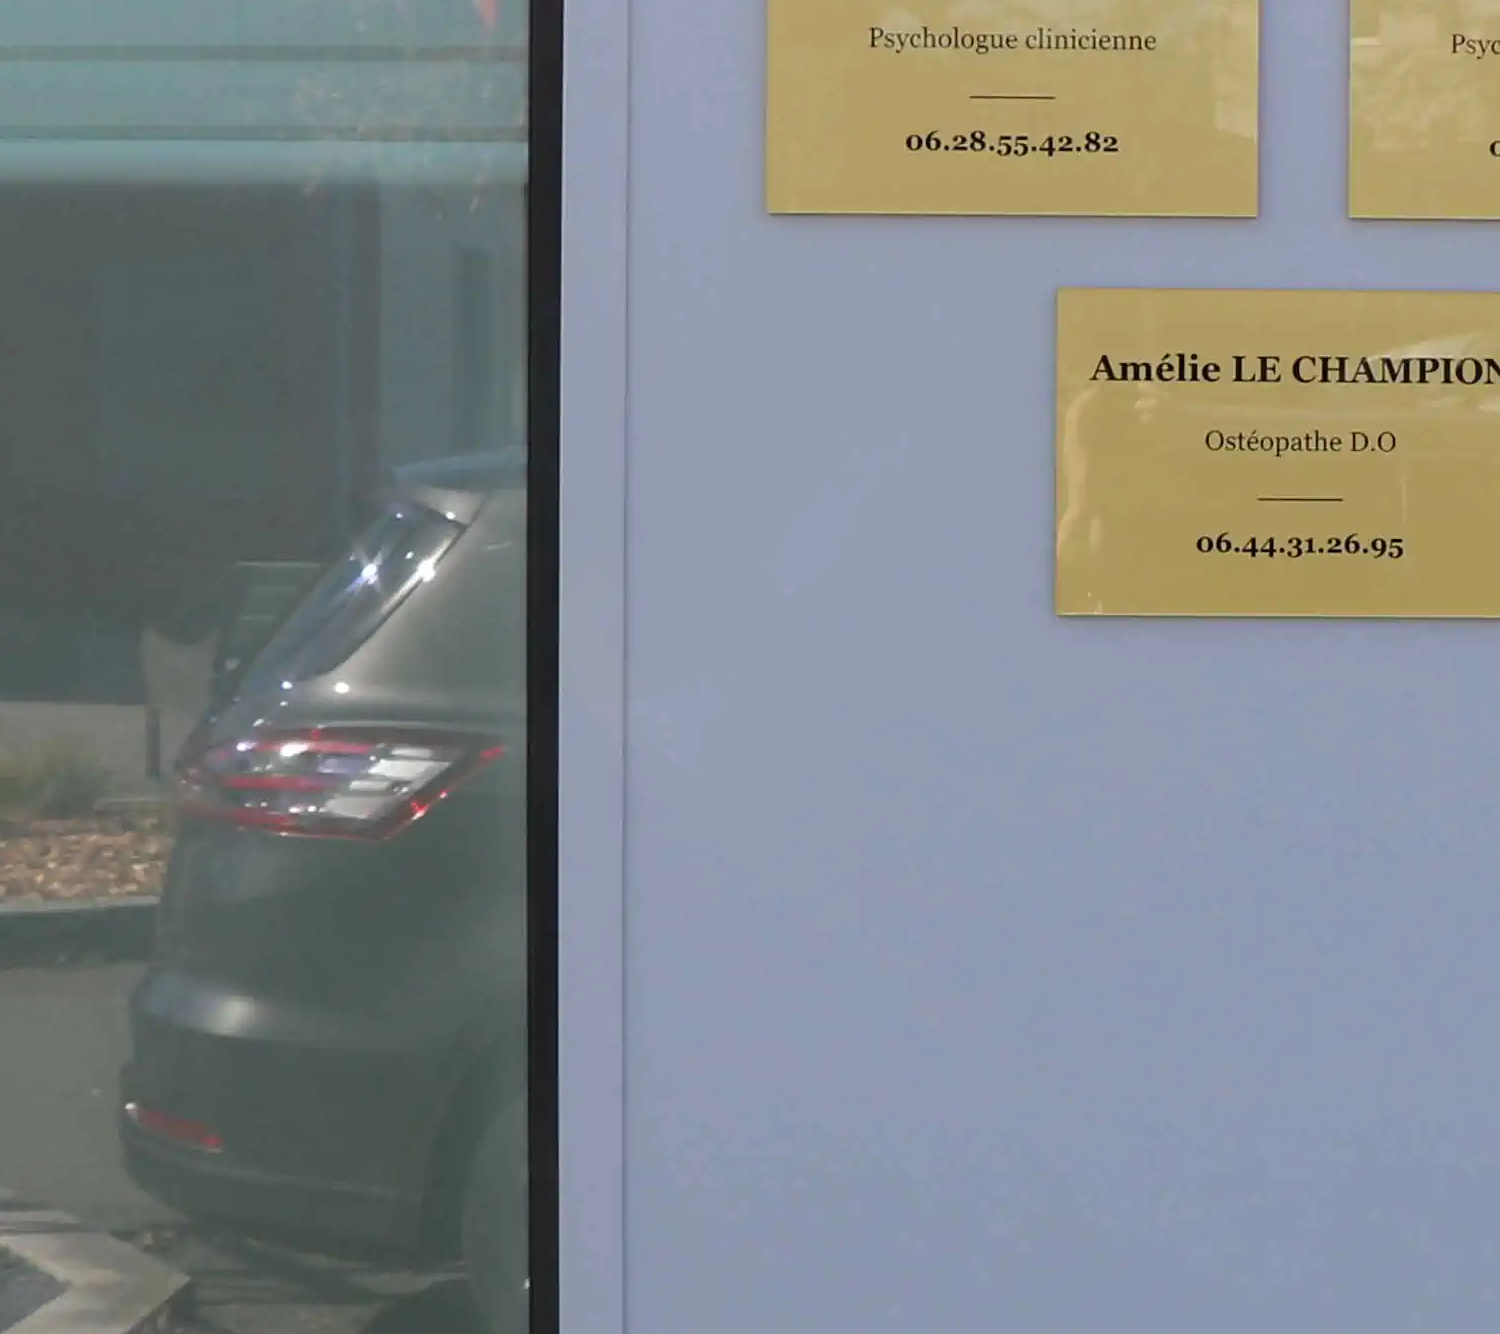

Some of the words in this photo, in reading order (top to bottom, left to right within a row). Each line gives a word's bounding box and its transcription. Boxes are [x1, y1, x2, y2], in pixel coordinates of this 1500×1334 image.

[868, 26, 1018, 55] Psychologue
[1025, 27, 1157, 51] clinicienne
[904, 130, 1120, 158] 06.28.55.42.82
[1089, 352, 1221, 383] Amélie
[1231, 355, 1282, 383] LE
[1204, 429, 1343, 457] Ostéopathe
[1350, 430, 1397, 453] D.O
[1195, 531, 1404, 560] 06.44.31.26.95
